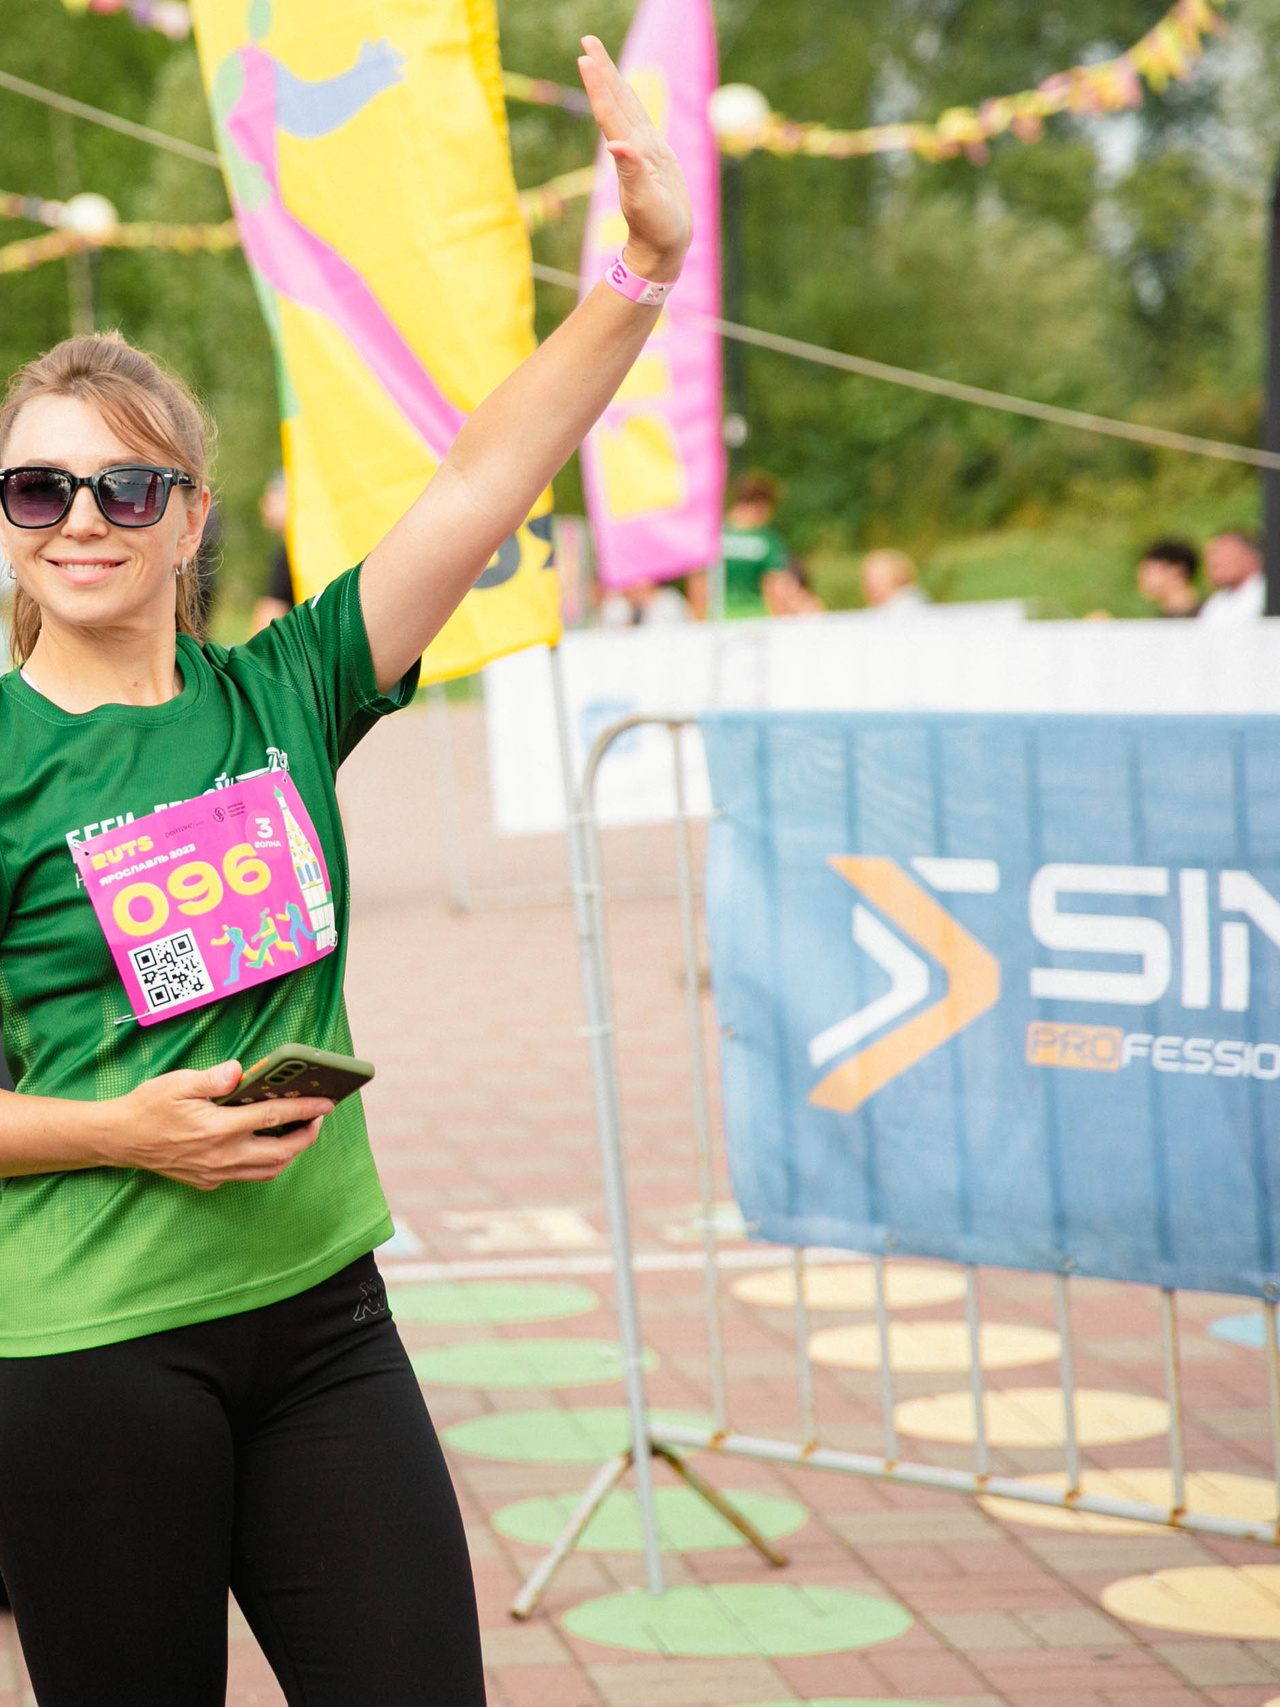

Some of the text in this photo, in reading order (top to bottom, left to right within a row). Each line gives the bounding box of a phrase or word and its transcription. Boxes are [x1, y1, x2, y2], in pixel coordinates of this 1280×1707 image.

[254, 817, 274, 839] 3
[254, 840, 282, 849] ВОЛНА
[91, 836, 154, 871] RUTS
[99, 855, 169, 887] ЯРОСЛАВЛЬ
[169, 843, 196, 860] 2023
[112, 842, 272, 937] 096
